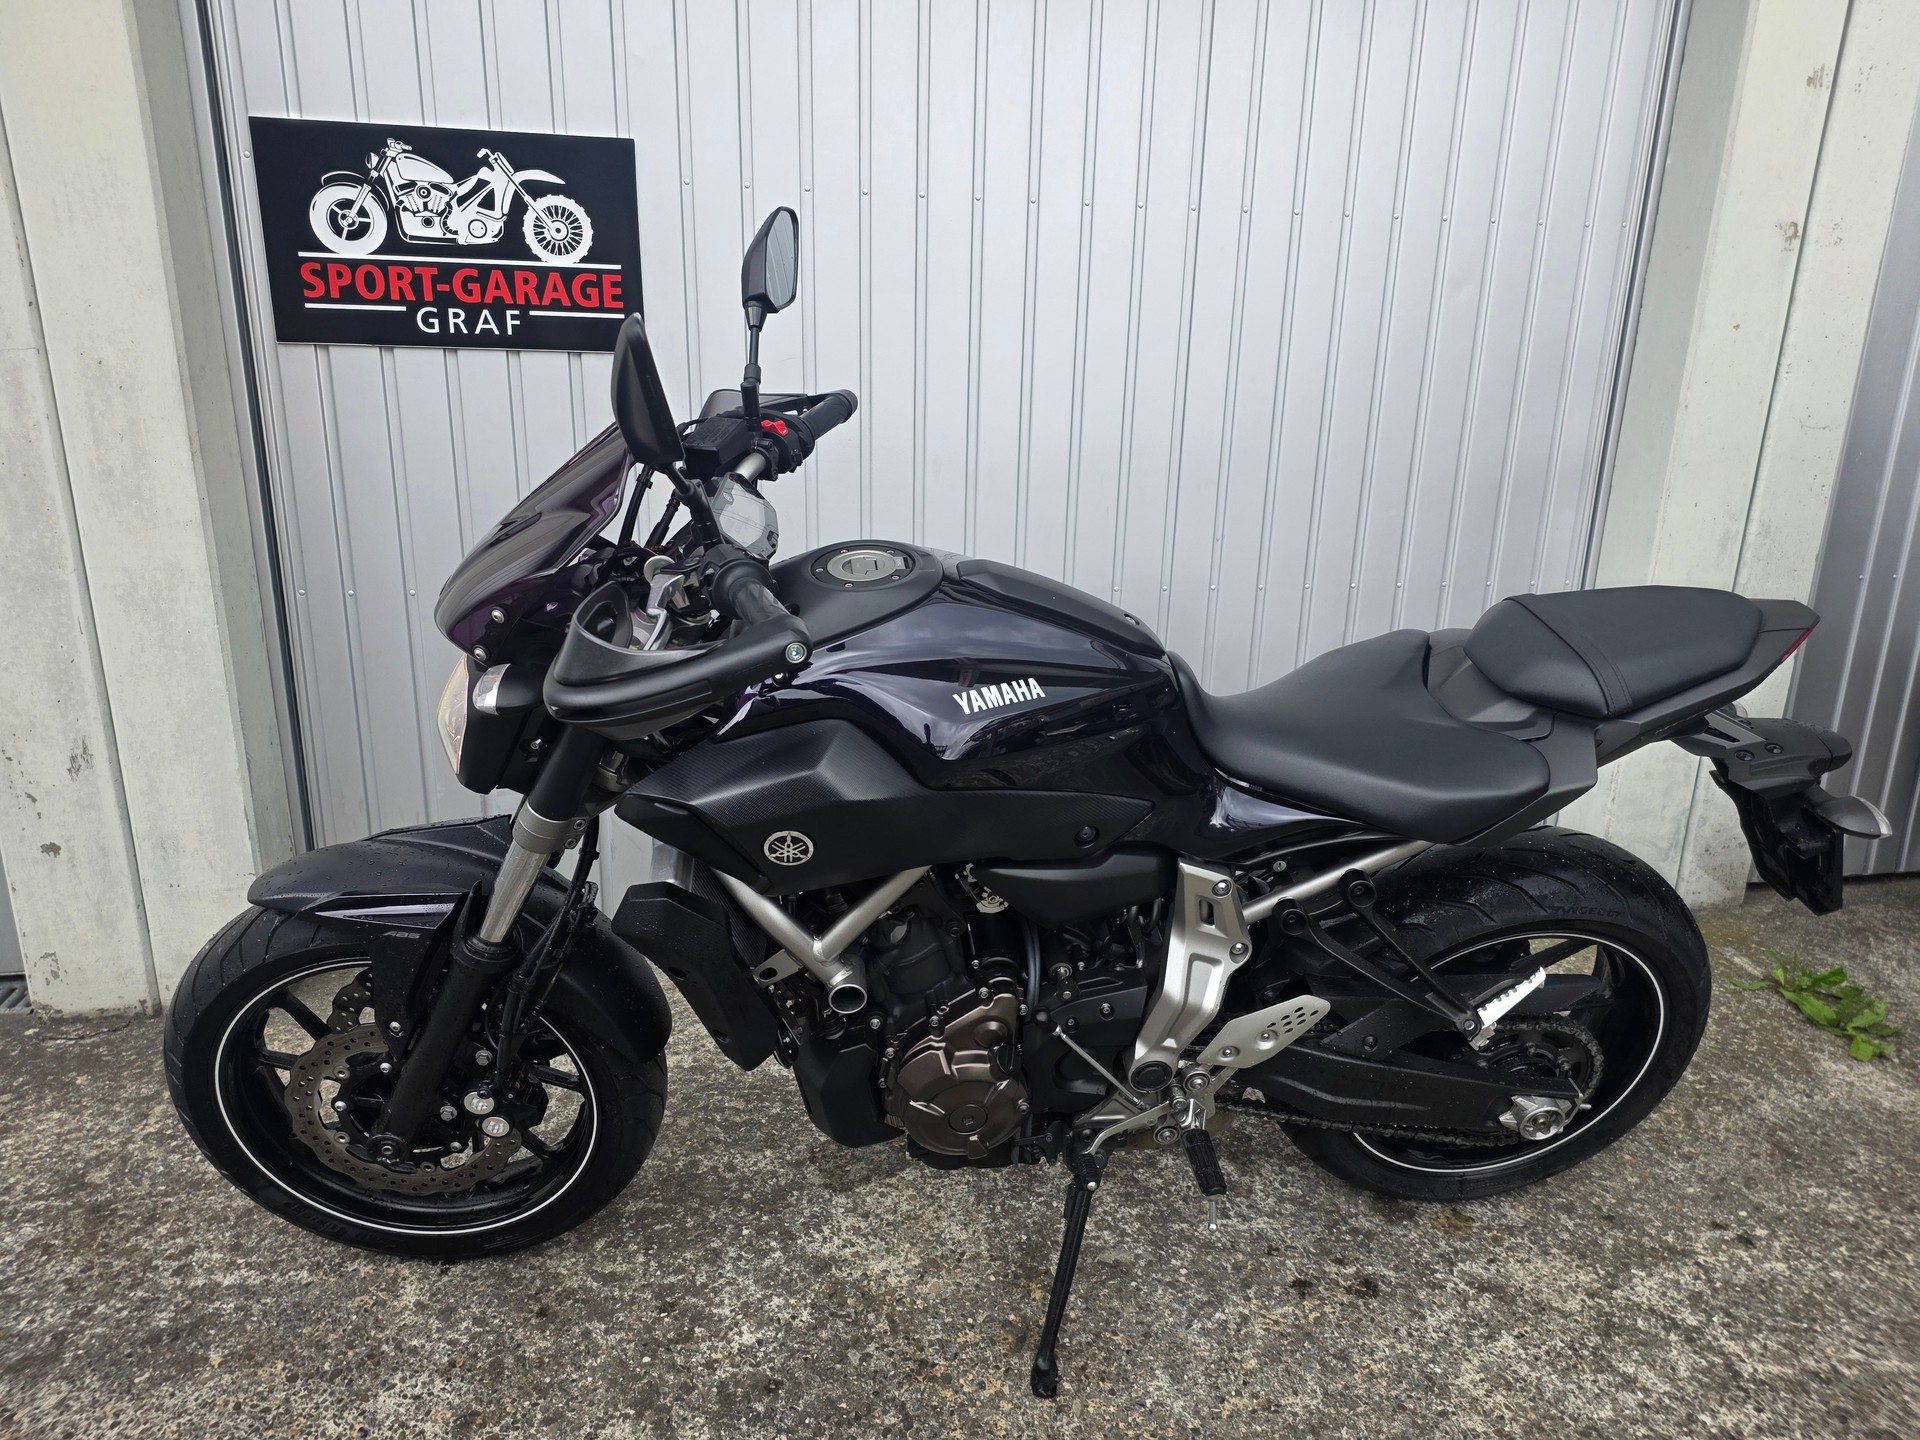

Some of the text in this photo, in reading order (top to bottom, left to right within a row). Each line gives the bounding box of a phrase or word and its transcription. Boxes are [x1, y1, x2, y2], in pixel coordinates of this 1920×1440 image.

[300, 262, 624, 309] SPORT-GARAGE
[416, 307, 522, 335] GRAF
[952, 677, 1046, 715] YAMAHA
[383, 931, 420, 939] ABS
